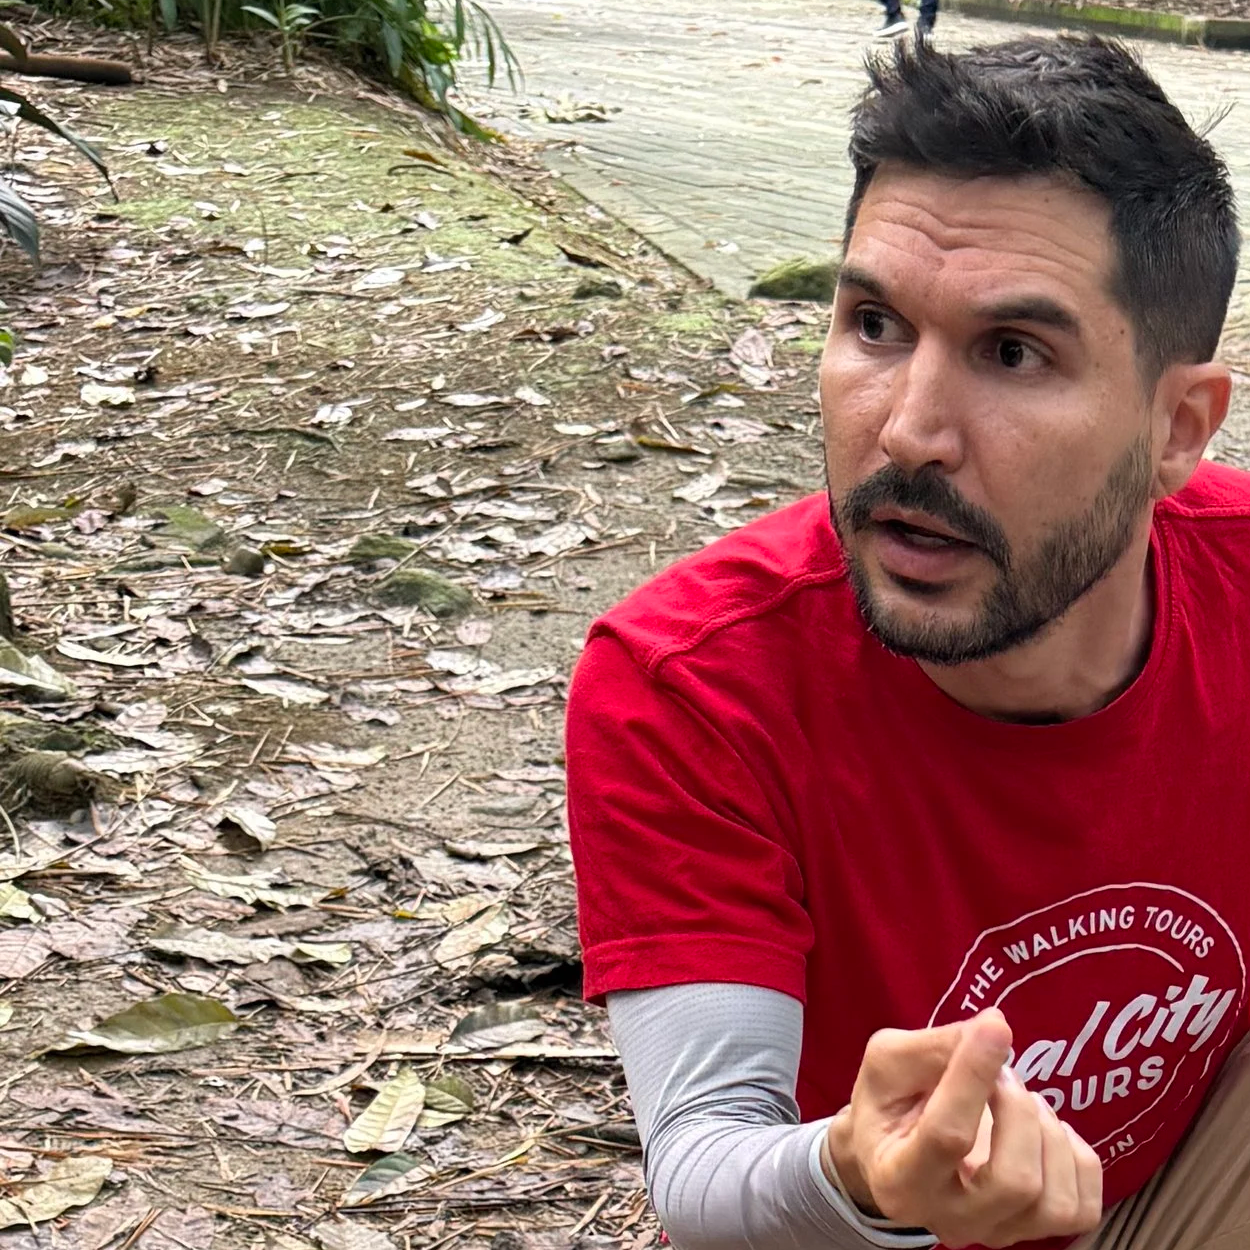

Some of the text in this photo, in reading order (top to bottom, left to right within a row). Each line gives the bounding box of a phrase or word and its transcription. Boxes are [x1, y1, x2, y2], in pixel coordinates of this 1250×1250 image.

[961, 905, 1215, 1013] THE WALKING TOURS
[1004, 974, 1237, 1082] al City
[1034, 1055, 1165, 1112] OURS
